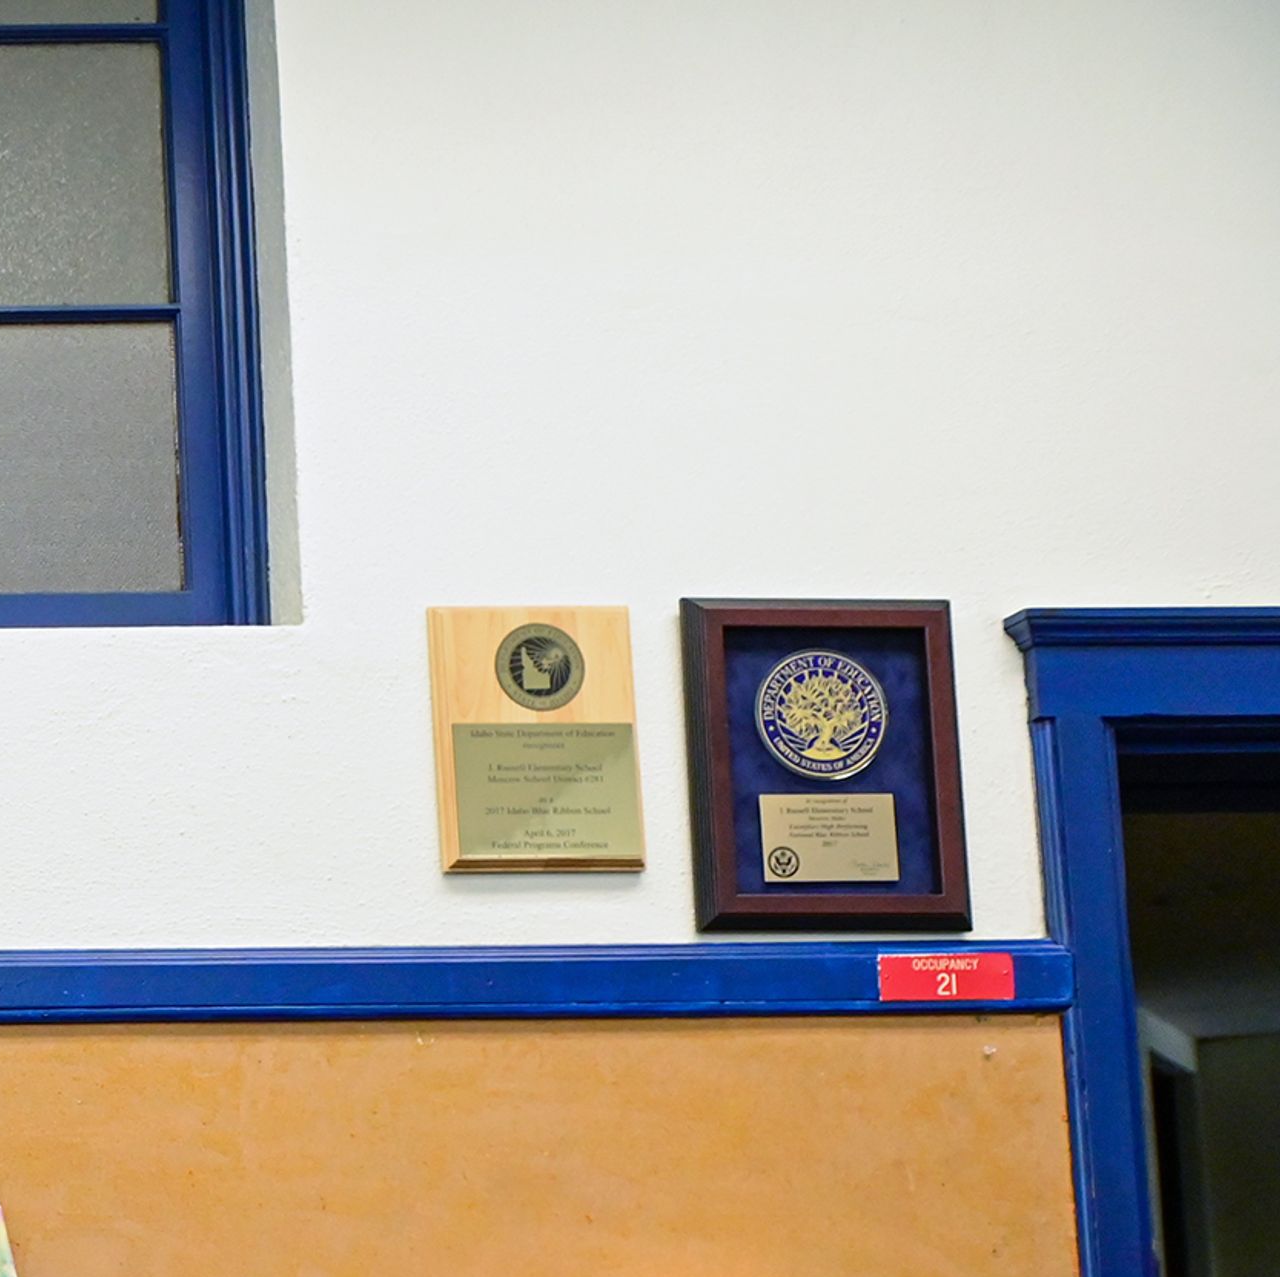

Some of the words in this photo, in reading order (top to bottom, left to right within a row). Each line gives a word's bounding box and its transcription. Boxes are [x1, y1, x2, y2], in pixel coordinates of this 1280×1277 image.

[763, 657, 815, 720] DEPARTMENT
[818, 656, 833, 668] OF
[837, 659, 882, 722] EDUCATION
[800, 758, 833, 772] STATES
[555, 827, 576, 838] 2017
[563, 839, 609, 850] Conference
[912, 958, 980, 971] OCCUPANCY
[936, 972, 958, 996] 21
